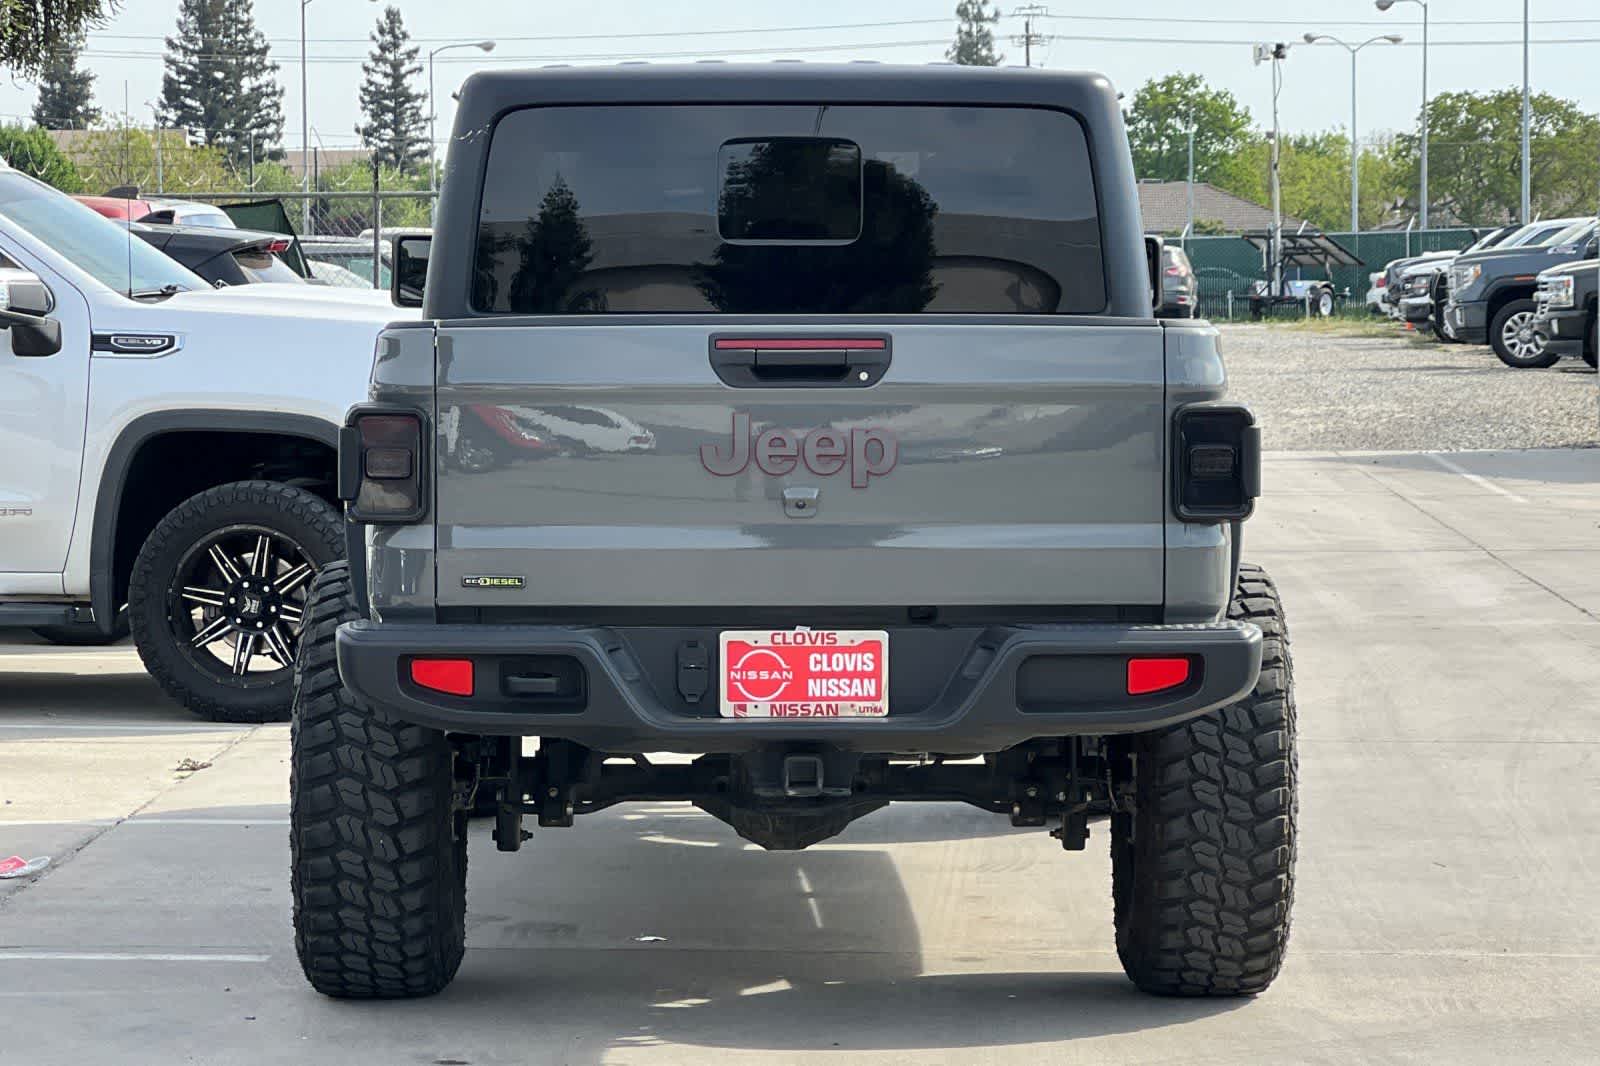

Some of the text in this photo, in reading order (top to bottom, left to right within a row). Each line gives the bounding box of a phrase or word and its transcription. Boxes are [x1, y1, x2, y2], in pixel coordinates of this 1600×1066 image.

[700, 412, 899, 489] Jeep
[770, 632, 838, 645] CLOVIS
[809, 653, 875, 672] CLOVIS
[729, 671, 793, 680] NISSAN
[808, 678, 876, 697] NISSAN
[770, 703, 839, 716] NISSAN
